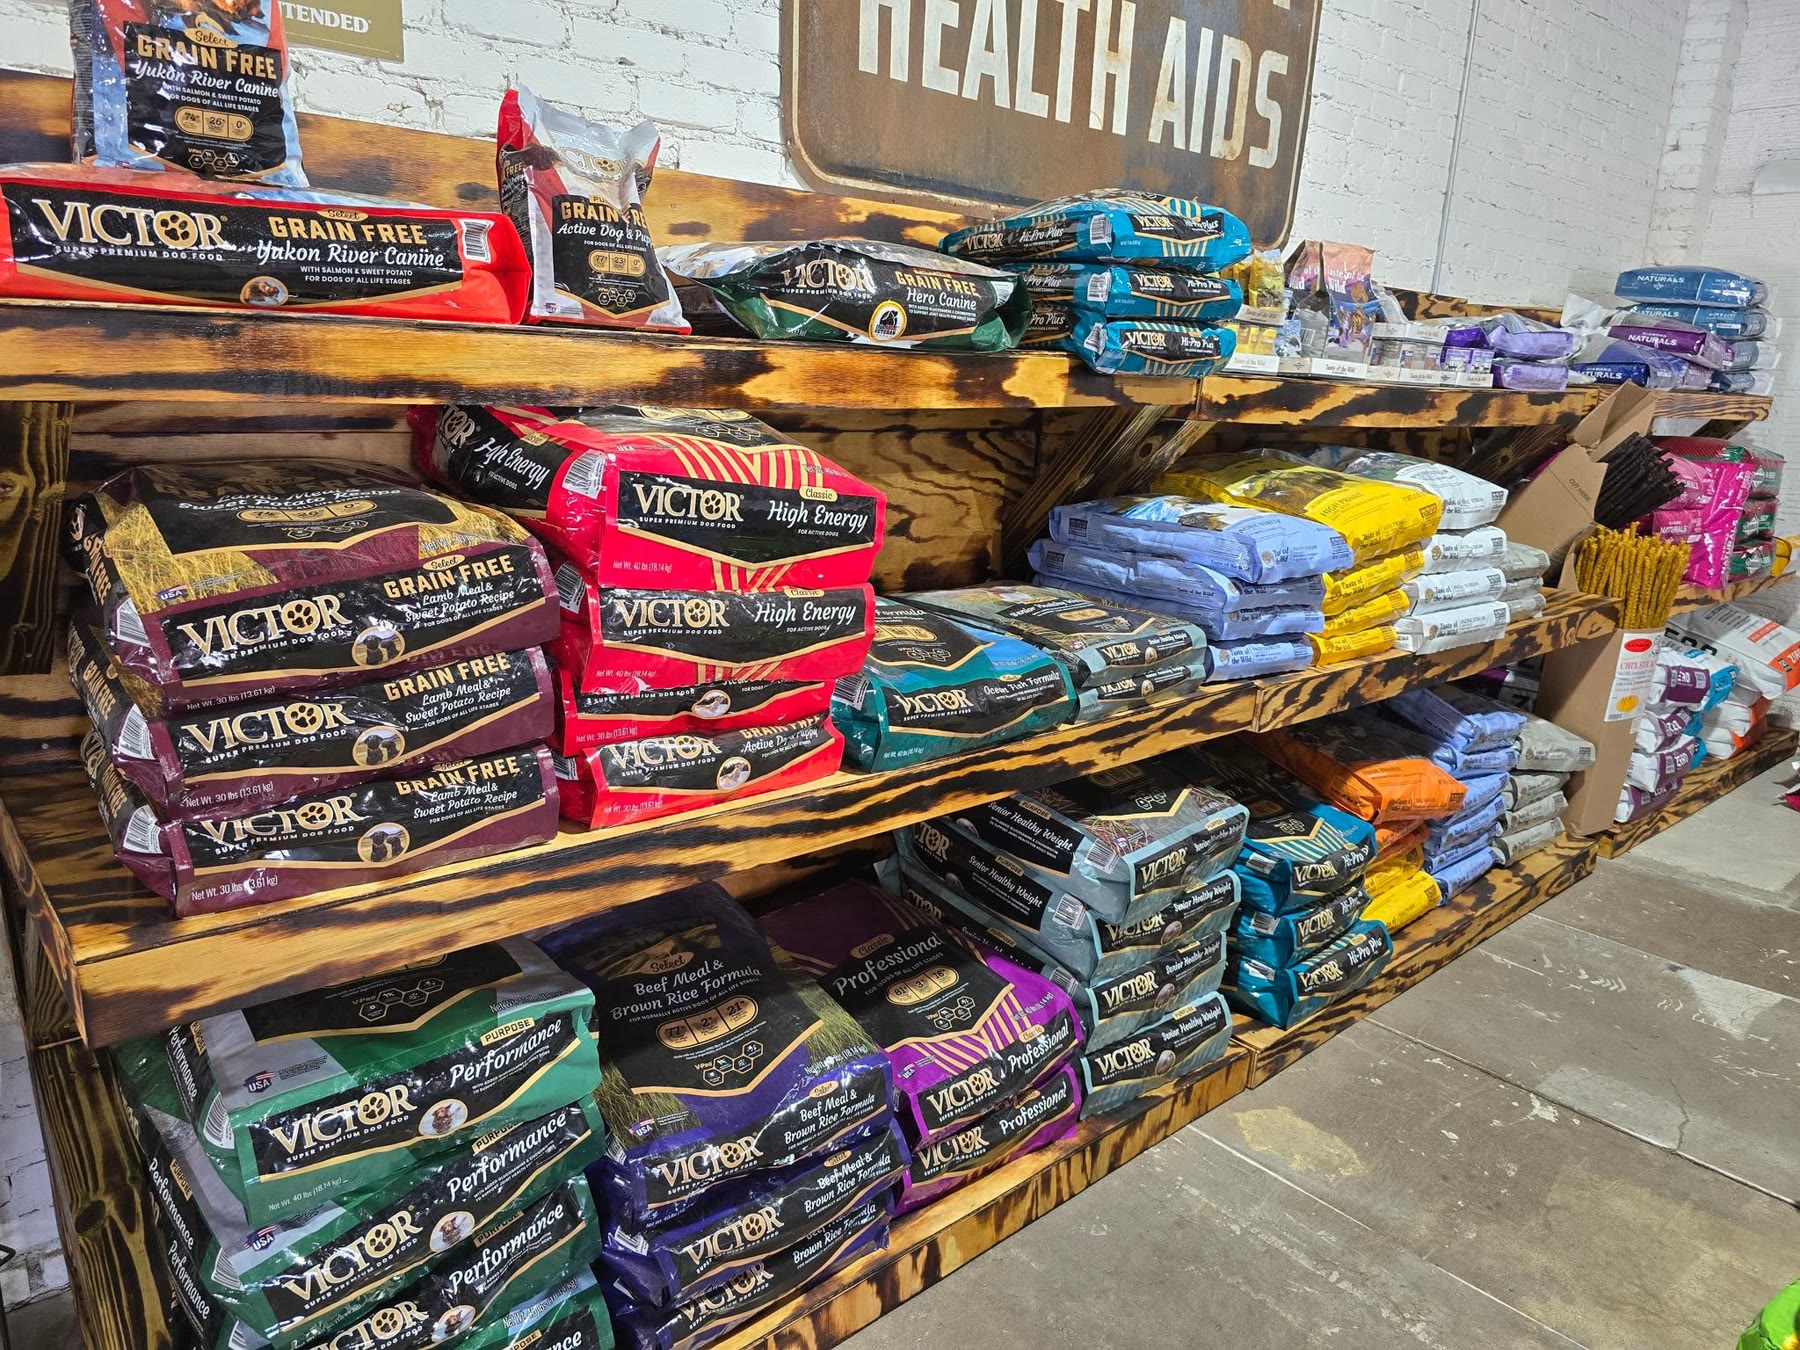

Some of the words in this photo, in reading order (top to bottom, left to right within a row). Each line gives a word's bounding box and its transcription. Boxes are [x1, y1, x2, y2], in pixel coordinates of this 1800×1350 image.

[278, 1, 368, 33] TENDED
[195, 30, 228, 46] Select
[138, 34, 217, 70] GRAIN
[226, 49, 277, 80] FREE
[134, 60, 186, 84] Yukon
[190, 70, 231, 90] River
[236, 78, 279, 98] Canine
[858, 0, 1136, 136] HEALTH
[1148, 16, 1289, 170] AIDS
[31, 199, 228, 249] VICTOR
[561, 201, 619, 223] GRAIN
[1136, 215, 1174, 228] VICTOR
[268, 216, 356, 242] GRAIN
[361, 223, 427, 244] FREE
[557, 222, 597, 237] Active
[600, 223, 624, 244] Dog
[627, 229, 634, 239] &
[965, 232, 1004, 250] VICTOR
[1020, 229, 1044, 243] Hi-Pro
[1045, 226, 1063, 241] Plus
[101, 248, 157, 258] PREMIUM
[163, 251, 187, 259] DOG
[192, 253, 223, 261] FOOD
[256, 240, 320, 266] Yukon
[327, 243, 381, 264] River
[384, 245, 444, 267] Canine
[781, 258, 875, 293] VICTOR
[895, 271, 942, 290] GRAIN
[943, 278, 981, 297] FREE
[1136, 275, 1174, 288] VICTOR
[1637, 275, 1685, 283] NATURALS
[907, 287, 935, 304] Hero
[940, 292, 976, 310] Canine
[1125, 331, 1166, 348] VICTOR
[1628, 334, 1677, 346] NATURALS
[507, 449, 550, 490] Energy
[632, 482, 744, 521] VICTOR
[805, 488, 833, 500] Classic
[1568, 479, 1580, 489] CUT
[1577, 487, 1591, 502] HERE
[767, 500, 812, 527] High
[814, 504, 869, 534] Energy
[1660, 526, 1688, 534] NATURALS
[383, 568, 456, 599] GRAIN
[459, 554, 515, 580] FREE
[431, 556, 459, 569] Select
[405, 608, 439, 624] Sweet
[441, 597, 477, 614] Potato
[479, 589, 515, 610] Recipe
[423, 590, 453, 606] Lamb
[618, 599, 730, 628] VICTOR
[177, 594, 352, 656] VICTOR
[755, 600, 797, 630] High
[802, 604, 856, 630] Energy
[1102, 642, 1140, 660] VICTOR
[383, 669, 455, 701] GRAIN
[459, 652, 511, 680] FREE
[1010, 679, 1025, 691] Fish
[1027, 671, 1061, 687] Formula
[895, 689, 975, 716] VICTOR
[181, 702, 355, 755] VICTOR
[606, 735, 722, 770] VICTOR
[395, 771, 466, 795] GRAIN
[467, 756, 520, 782] FREE
[186, 798, 200, 808] Net
[201, 795, 214, 805] Wt.
[215, 792, 226, 801] 30
[228, 790, 239, 800] lbs
[240, 784, 261, 799] (13.61
[262, 780, 274, 793] kg)
[413, 805, 445, 819] Sweet
[448, 797, 481, 811] Potato
[484, 790, 517, 806] Recipe
[1020, 801, 1050, 819] PURPOSE
[200, 796, 366, 843] VICTOR
[988, 801, 1011, 820] Senior
[1011, 809, 1041, 838] Healthy
[1042, 828, 1074, 852] Weight
[1141, 849, 1187, 885] VICTOR
[1294, 860, 1339, 884] VICTOR
[859, 935, 890, 955] Classic
[1347, 944, 1371, 967] Hi-Pro
[1371, 935, 1383, 952] Plus
[634, 978, 669, 998] Beef
[672, 962, 711, 988] Meal
[712, 959, 724, 971] &
[650, 954, 686, 973] Select
[833, 932, 945, 996] Professional
[1298, 960, 1343, 989] VICTOR
[611, 996, 663, 1021] Brown
[666, 987, 698, 1007] Rice
[700, 965, 762, 996] Formula
[484, 1018, 532, 1044] PURPOSE
[1161, 1026, 1178, 1042] Senior
[1179, 1015, 1201, 1034] Healthy
[1201, 1005, 1223, 1024] Weight
[451, 1018, 563, 1088] Performance
[1008, 1019, 1069, 1073] Professional
[1094, 1036, 1156, 1076] VICTOR
[800, 1100, 822, 1121] Beef
[824, 1091, 849, 1112] Meal
[849, 1089, 857, 1100] &
[927, 1067, 1000, 1117] VICTOR
[272, 1083, 418, 1155] VICTOR
[785, 1123, 817, 1146] Brown
[819, 1114, 838, 1129] Rice
[840, 1094, 875, 1119] Formula
[999, 1082, 1068, 1135] Professional
[286, 1148, 318, 1163] SUPER
[319, 1131, 361, 1152] PREMIUM
[364, 1124, 384, 1135] DOG
[386, 1114, 410, 1128] FOOD
[447, 1113, 568, 1202] Performance
[657, 1134, 764, 1187] VICTOR
[281, 1208, 423, 1302] VICTOR
[450, 1203, 564, 1294] Performance
